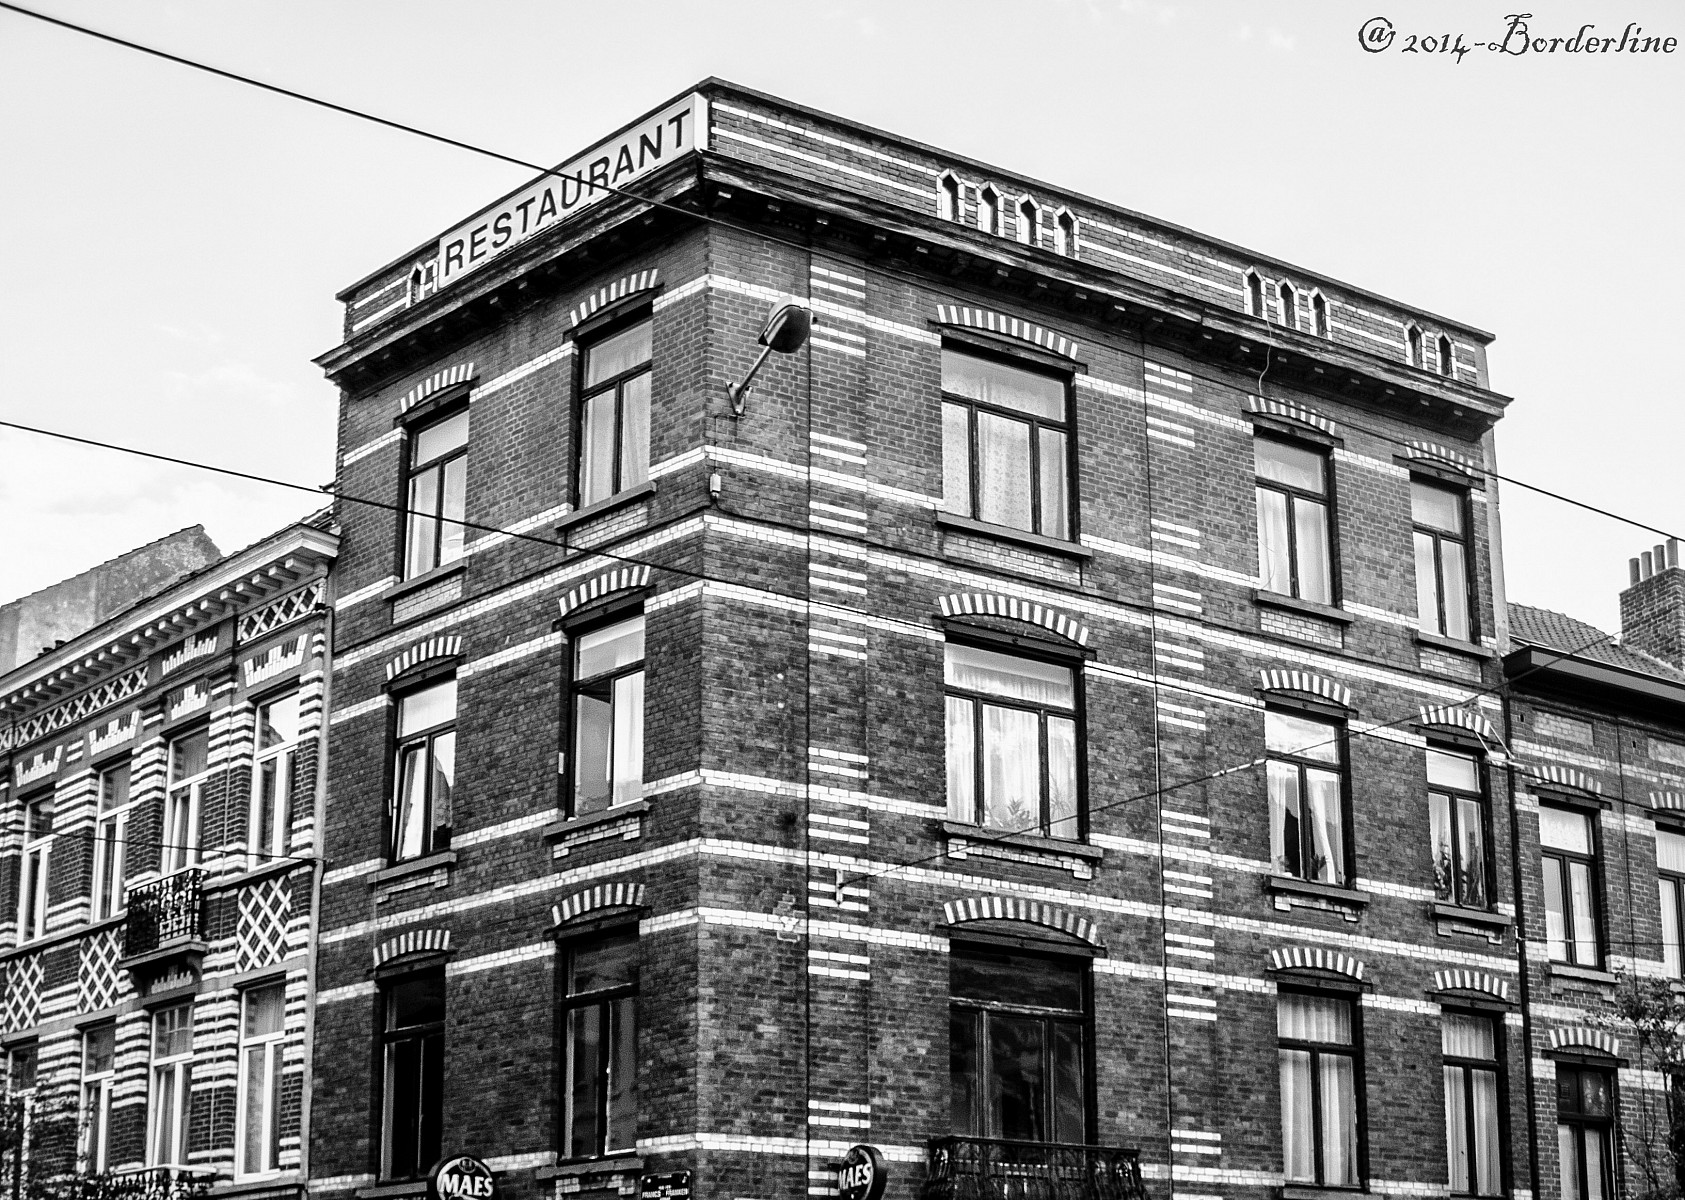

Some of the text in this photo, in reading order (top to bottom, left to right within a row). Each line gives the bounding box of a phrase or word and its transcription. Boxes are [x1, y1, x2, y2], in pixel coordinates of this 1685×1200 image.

[444, 107, 691, 278] RESTAURANT
[440, 1173, 493, 1197] MAES
[838, 1162, 871, 1190] MAES
